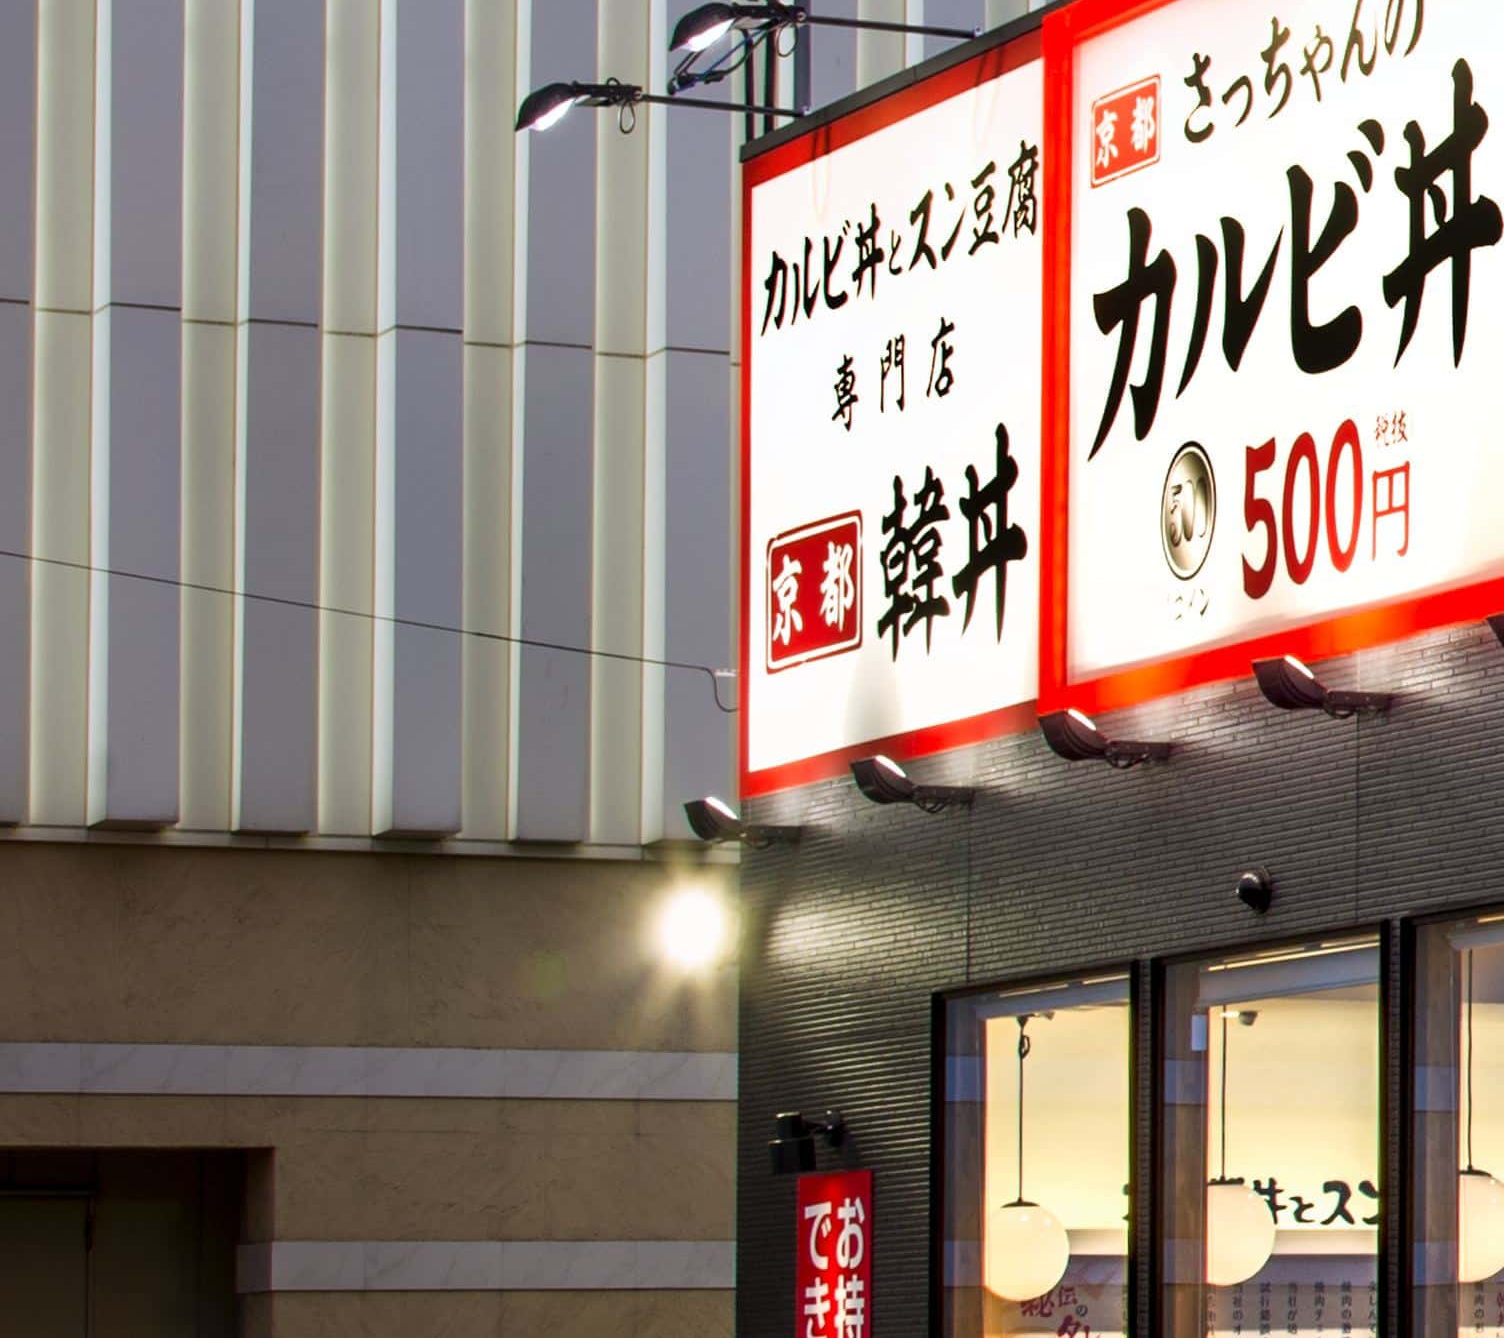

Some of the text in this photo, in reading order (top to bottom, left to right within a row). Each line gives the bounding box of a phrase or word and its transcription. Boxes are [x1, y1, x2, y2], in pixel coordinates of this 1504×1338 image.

[1095, 95, 1156, 169] 京都
[761, 140, 1039, 337] カルビ丼とスン豆腐
[1087, 57, 1504, 462] カルビ丼
[832, 317, 955, 433] 専門店
[772, 540, 855, 646] 京都
[878, 422, 1028, 663] 韓丼
